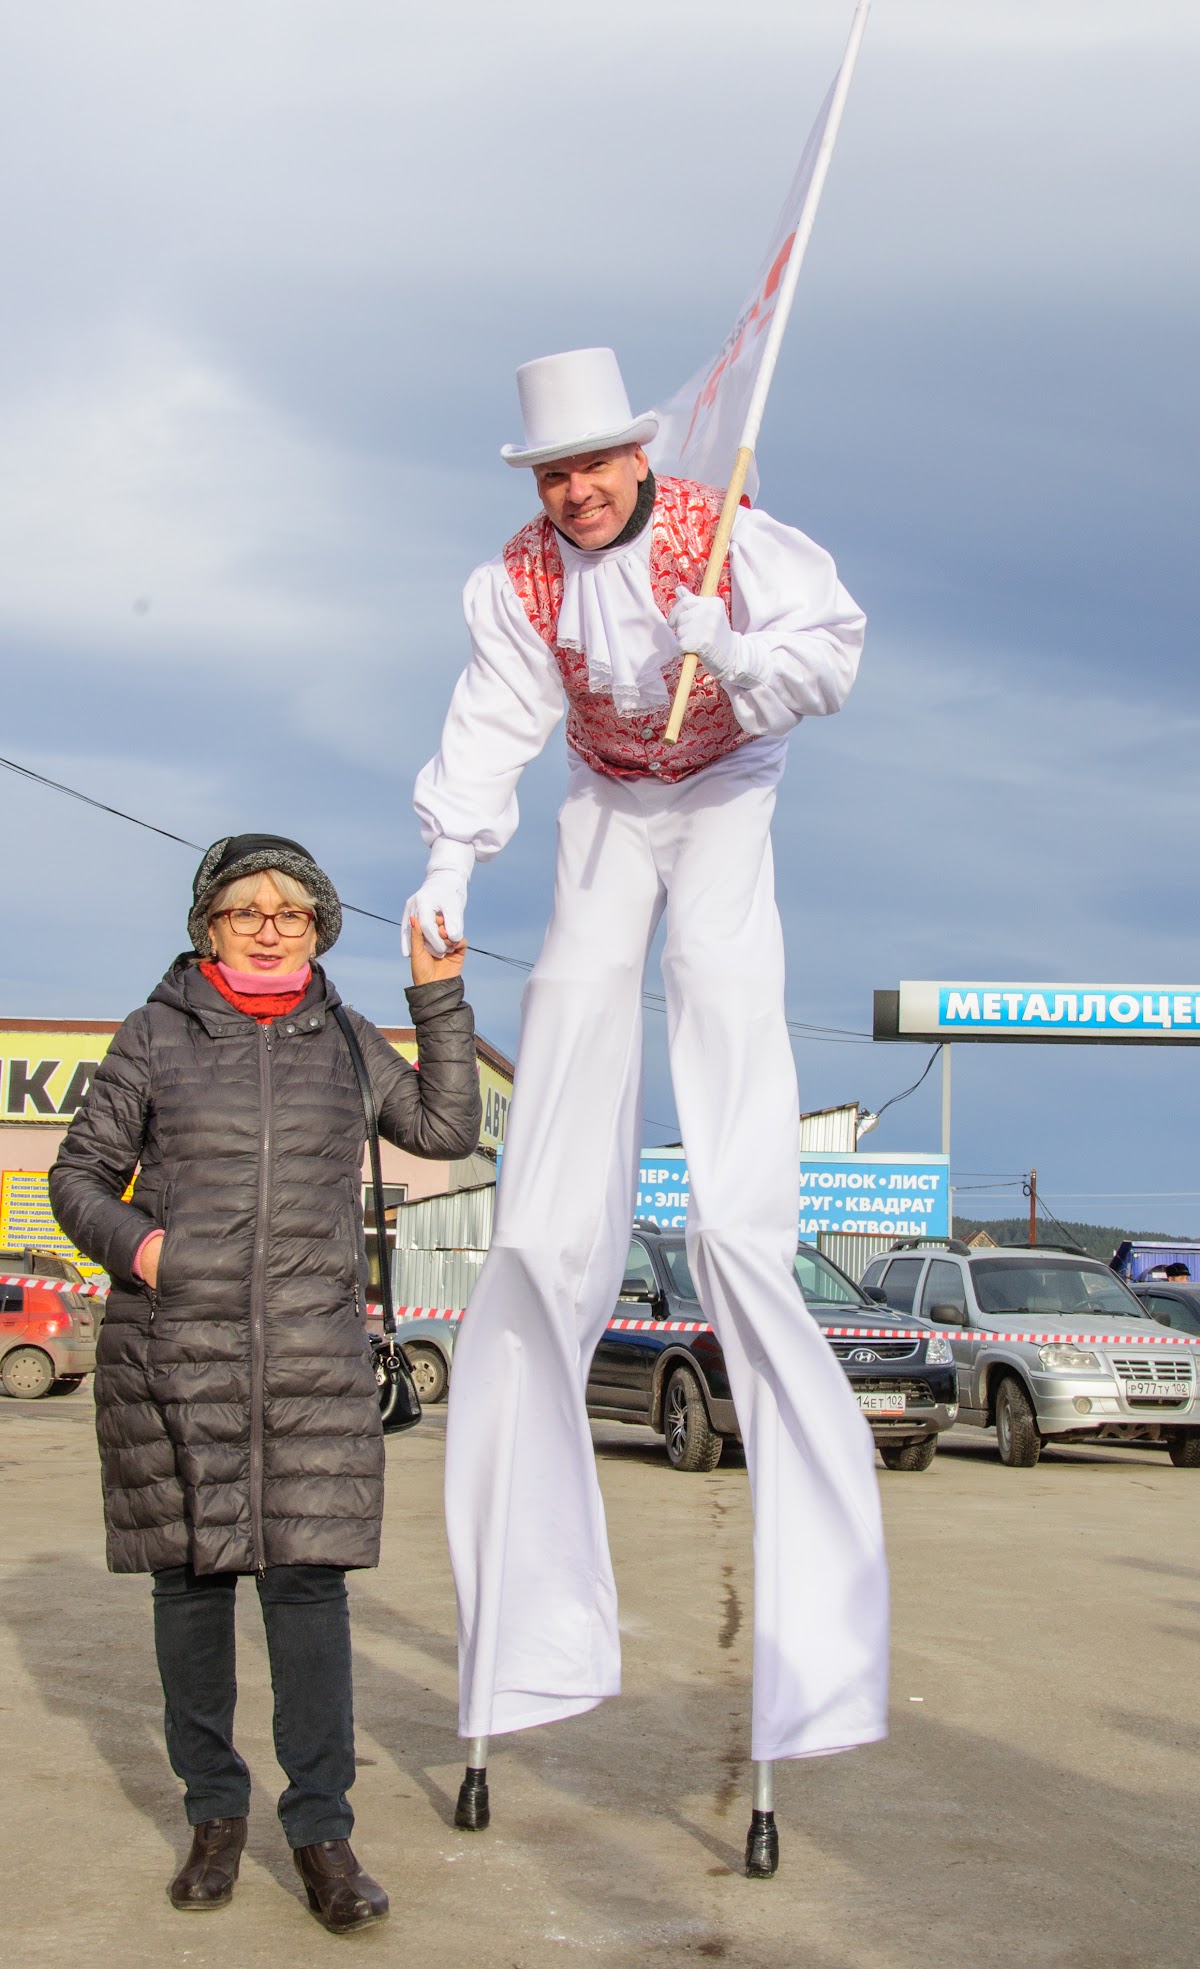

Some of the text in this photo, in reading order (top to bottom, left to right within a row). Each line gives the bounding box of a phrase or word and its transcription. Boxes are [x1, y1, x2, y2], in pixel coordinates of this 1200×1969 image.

[0, 1059, 99, 1115] КА
[799, 1173, 940, 1190] УГОЛОК ЛИСТ
[845, 1197, 935, 1215] КВАДРАТ
[841, 1219, 927, 1236] ОТВОДЫ
[1172, 1383, 1186, 1392] 102
[887, 1395, 903, 1405] 102
